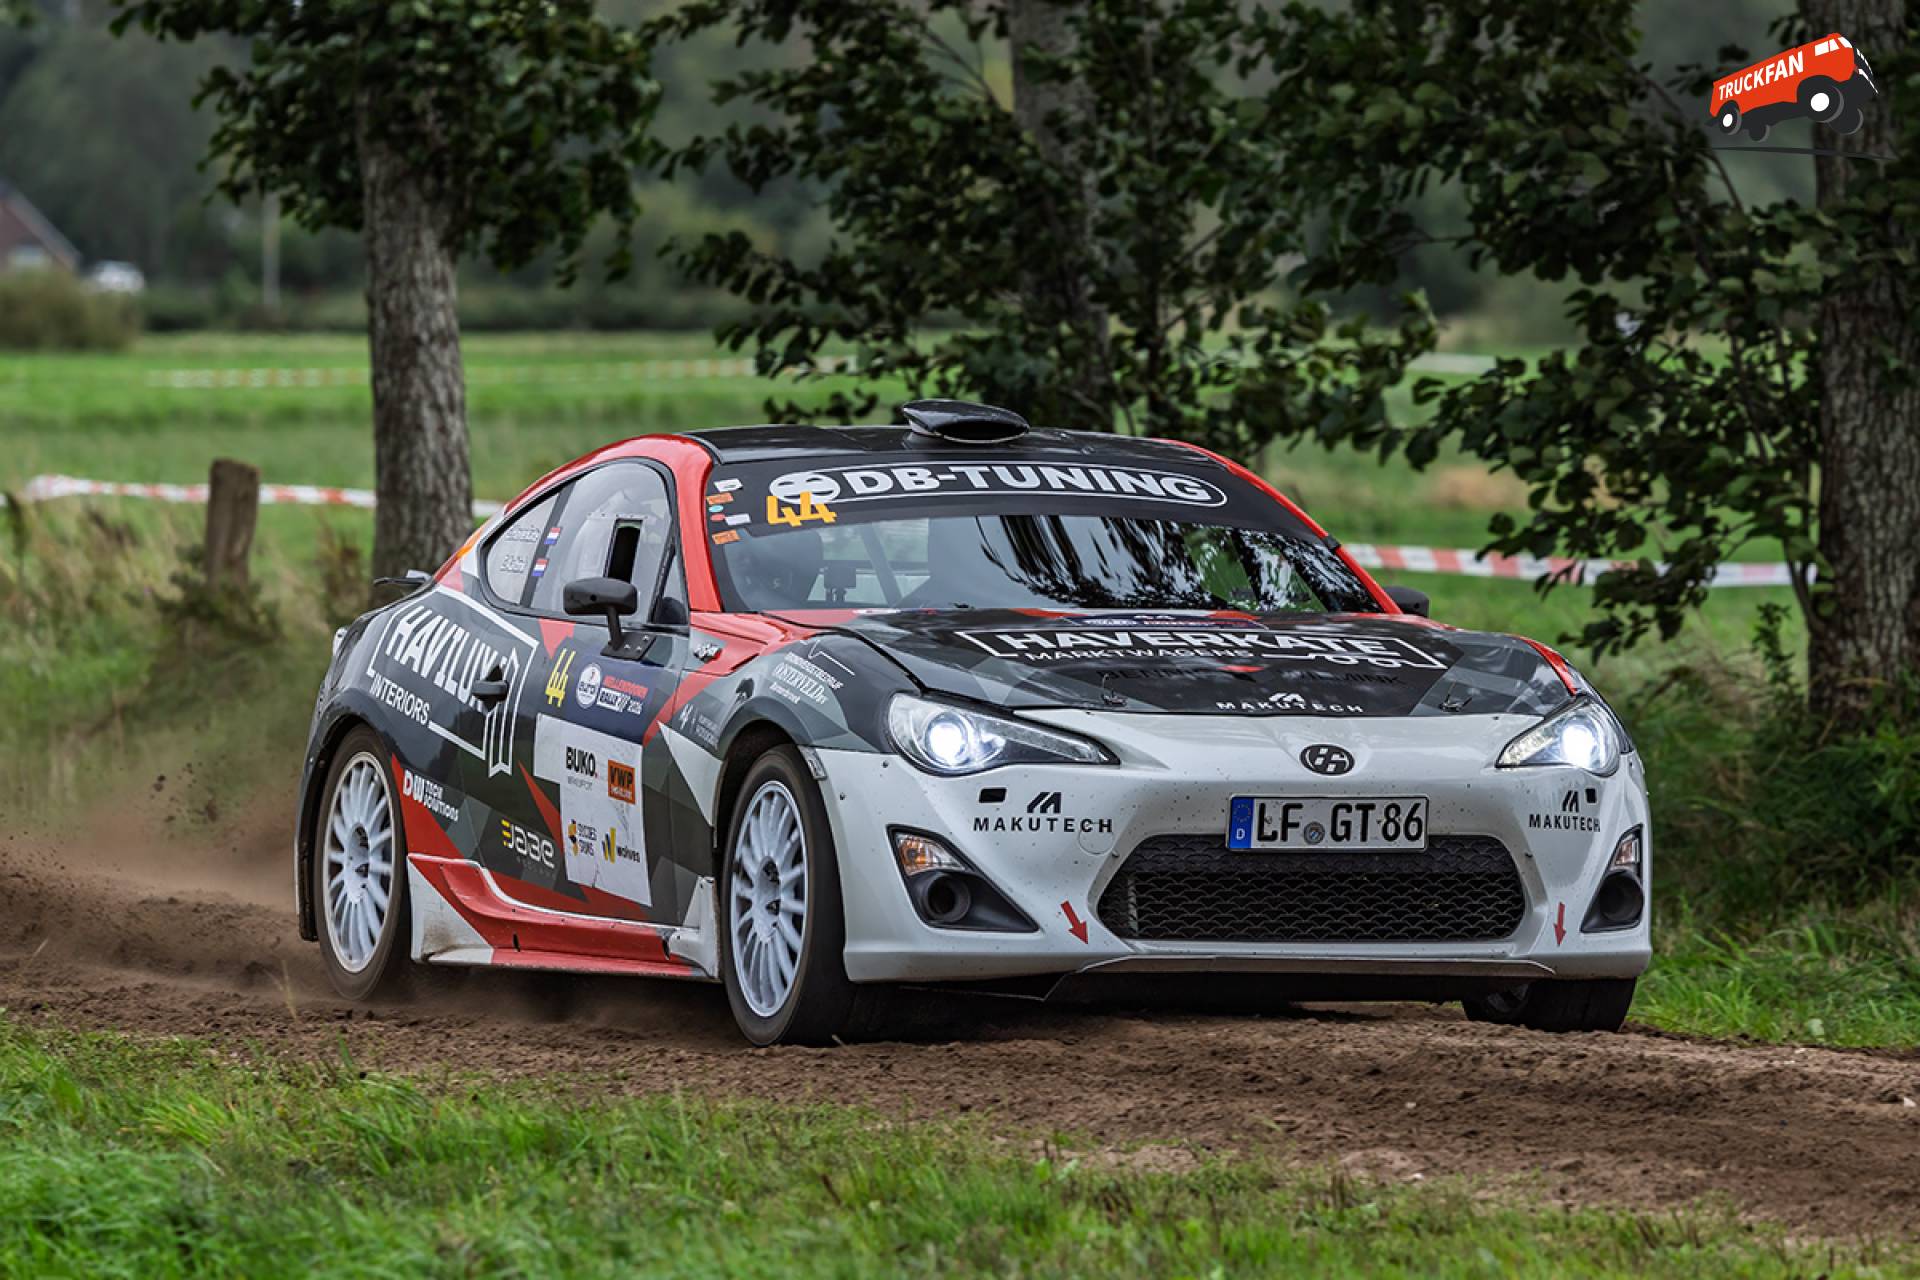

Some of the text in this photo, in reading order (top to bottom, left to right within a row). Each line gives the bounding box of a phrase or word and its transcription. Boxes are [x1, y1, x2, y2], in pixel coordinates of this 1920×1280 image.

[845, 464, 1214, 503] DB-TUNING
[766, 491, 837, 528] 44
[1001, 631, 1400, 658] HAVERKATE
[1025, 646, 1256, 661] MARKTWAGENS
[545, 648, 576, 708] 44
[370, 674, 430, 726] INTERIORS
[1216, 700, 1364, 714] MAKUTECH
[972, 814, 1114, 835] MAKUTECH
[1235, 828, 1246, 841] D
[1257, 803, 1303, 842] LF
[1528, 814, 1601, 833] MAKUTECH
